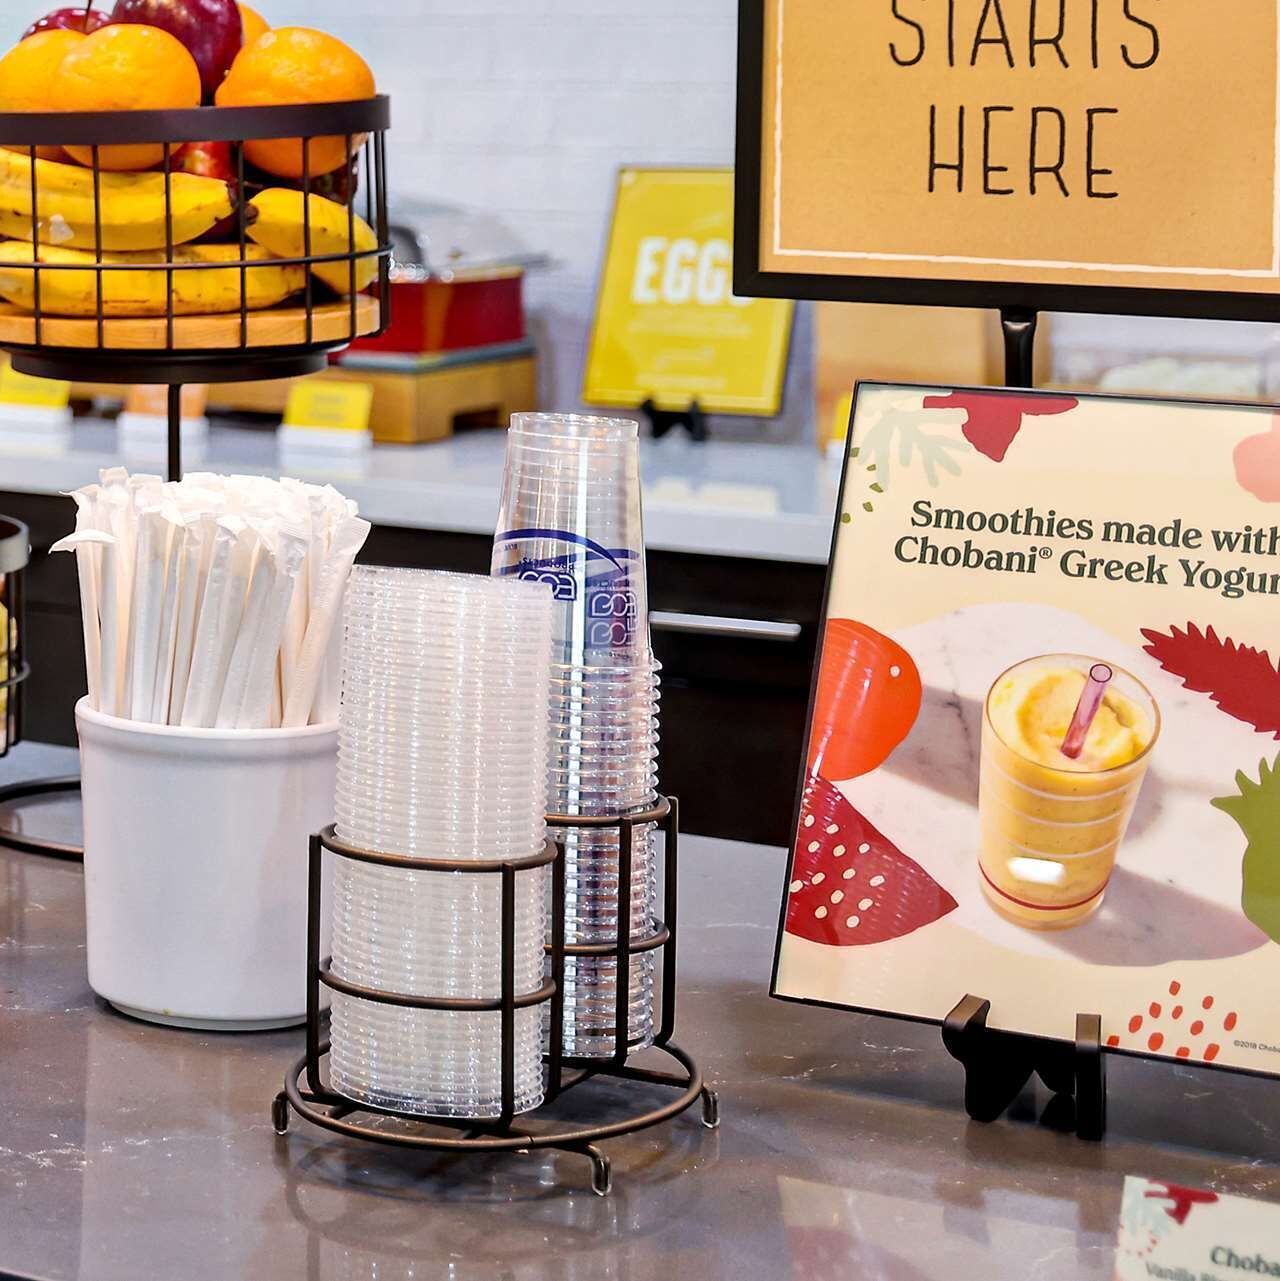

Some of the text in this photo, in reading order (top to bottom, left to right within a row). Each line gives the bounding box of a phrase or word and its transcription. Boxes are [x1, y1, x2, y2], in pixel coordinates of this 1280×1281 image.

[926, 103, 1120, 199] HERE
[632, 237, 753, 305] EGG
[910, 500, 1093, 540] Smoothies
[1100, 517, 1203, 551] made
[1059, 549, 1169, 585] Greek
